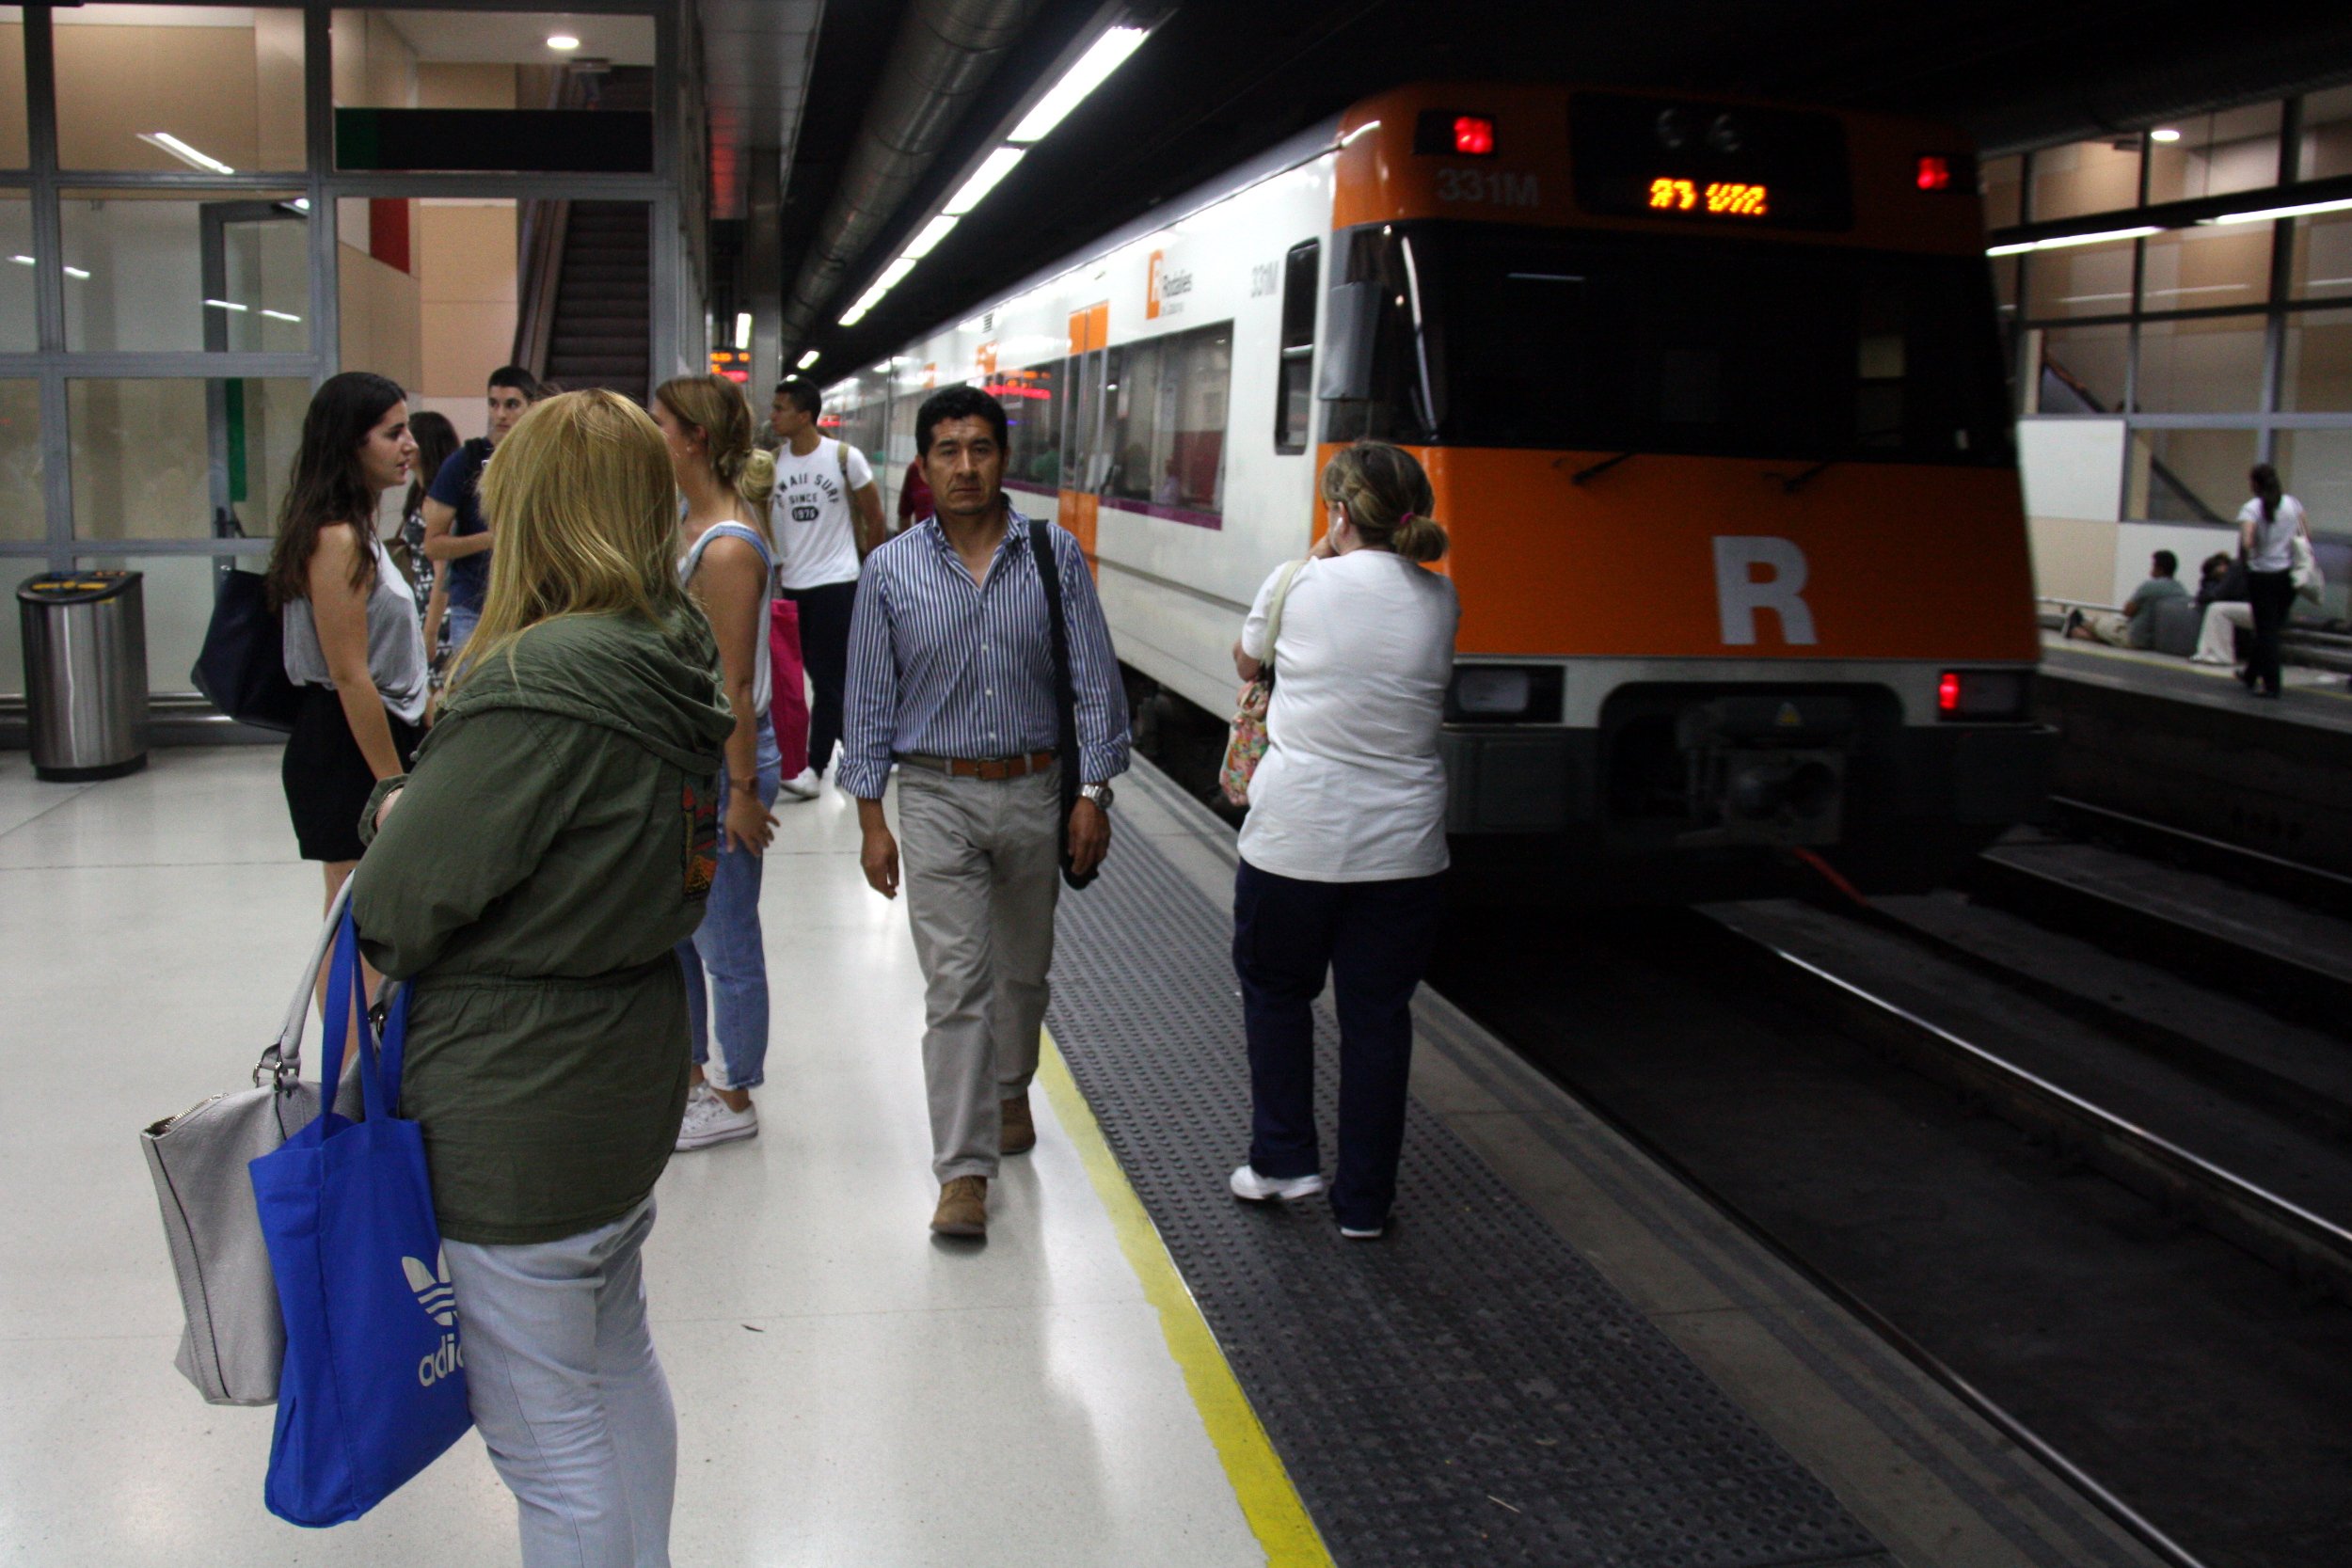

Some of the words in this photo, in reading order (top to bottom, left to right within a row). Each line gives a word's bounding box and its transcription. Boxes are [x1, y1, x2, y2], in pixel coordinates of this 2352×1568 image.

[1436, 166, 1540, 207] 331M
[788, 491, 818, 504] SINCE
[1710, 534, 1820, 645] R
